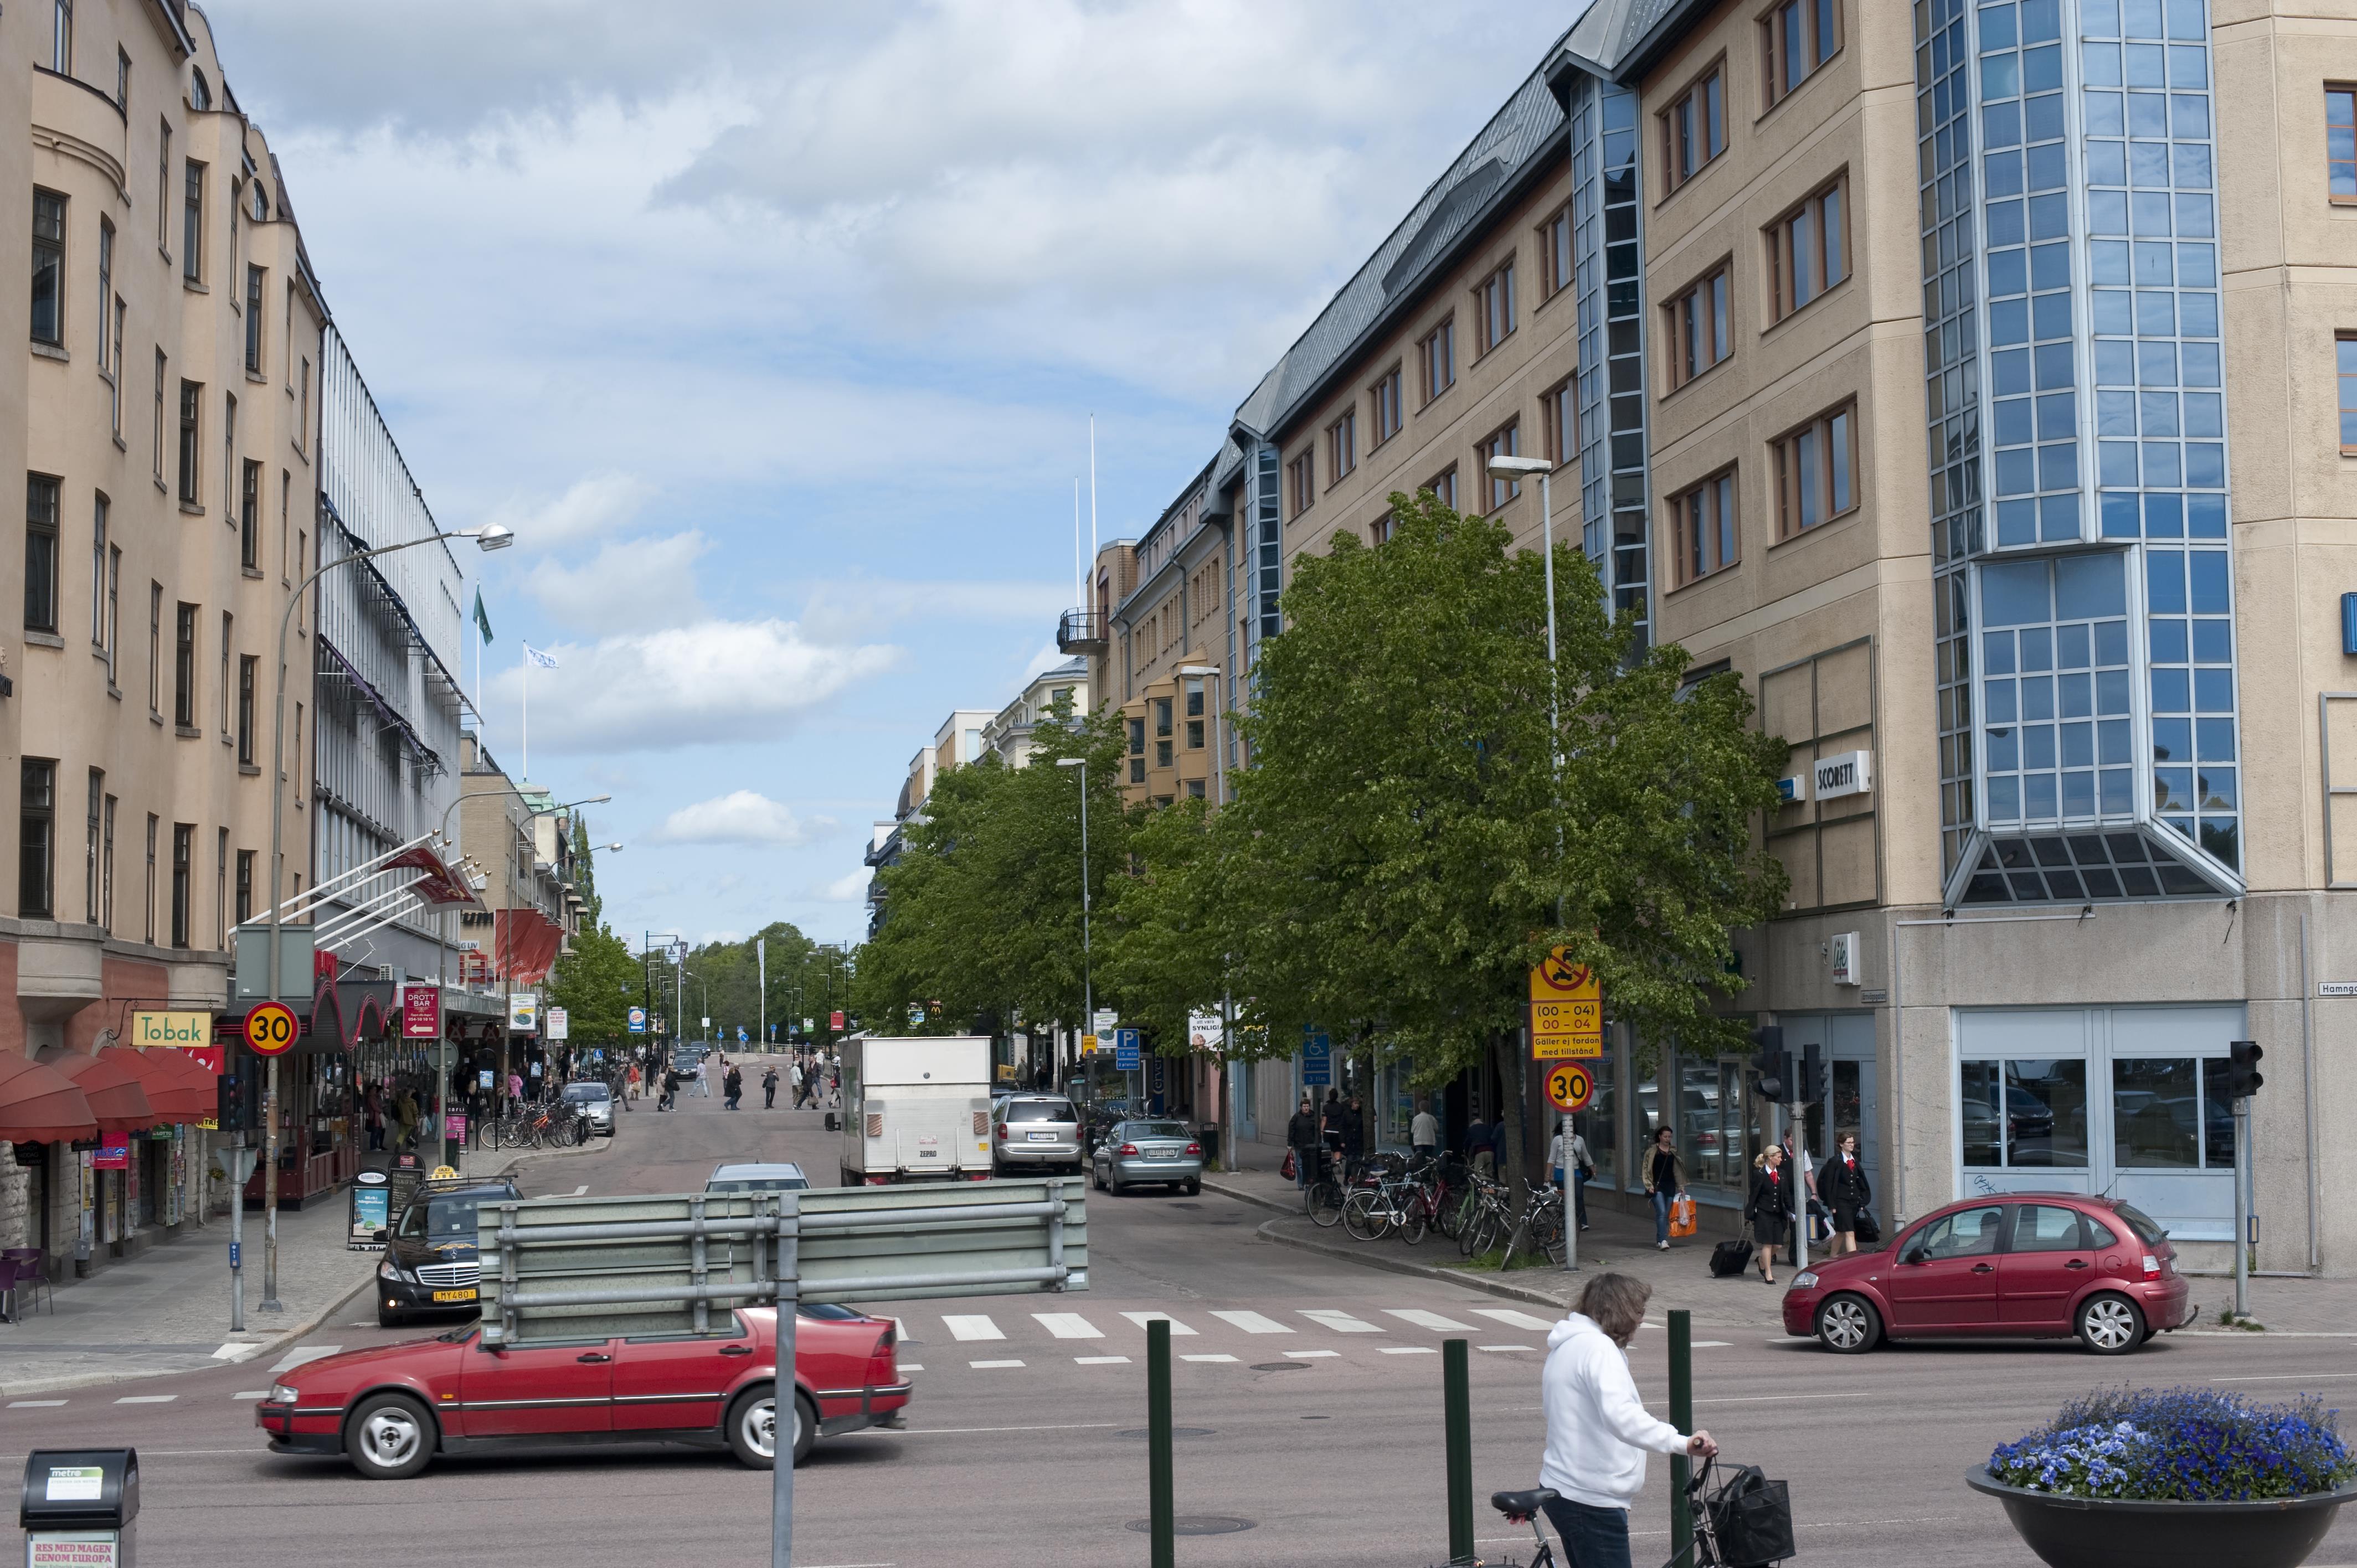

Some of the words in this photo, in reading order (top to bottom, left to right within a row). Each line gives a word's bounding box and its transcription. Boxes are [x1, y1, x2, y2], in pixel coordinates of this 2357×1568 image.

[1818, 762, 1854, 790] SCORETT
[1833, 938, 1847, 979] life
[1537, 1005, 1559, 1017] (00
[1574, 1004, 1594, 1016] 04)
[141, 1017, 202, 1041] Tobak
[253, 1015, 290, 1042] 30
[1542, 1020, 1559, 1029] 00
[1574, 1019, 1591, 1029] 04
[1124, 1031, 1134, 1046] P
[1553, 1075, 1586, 1100] 30
[94, 1147, 114, 1157] V65
[35, 1544, 53, 1552] RES
[78, 1544, 112, 1553] MAGEN
[35, 1554, 70, 1562] GENOM
[72, 1554, 112, 1563] EUROPA
